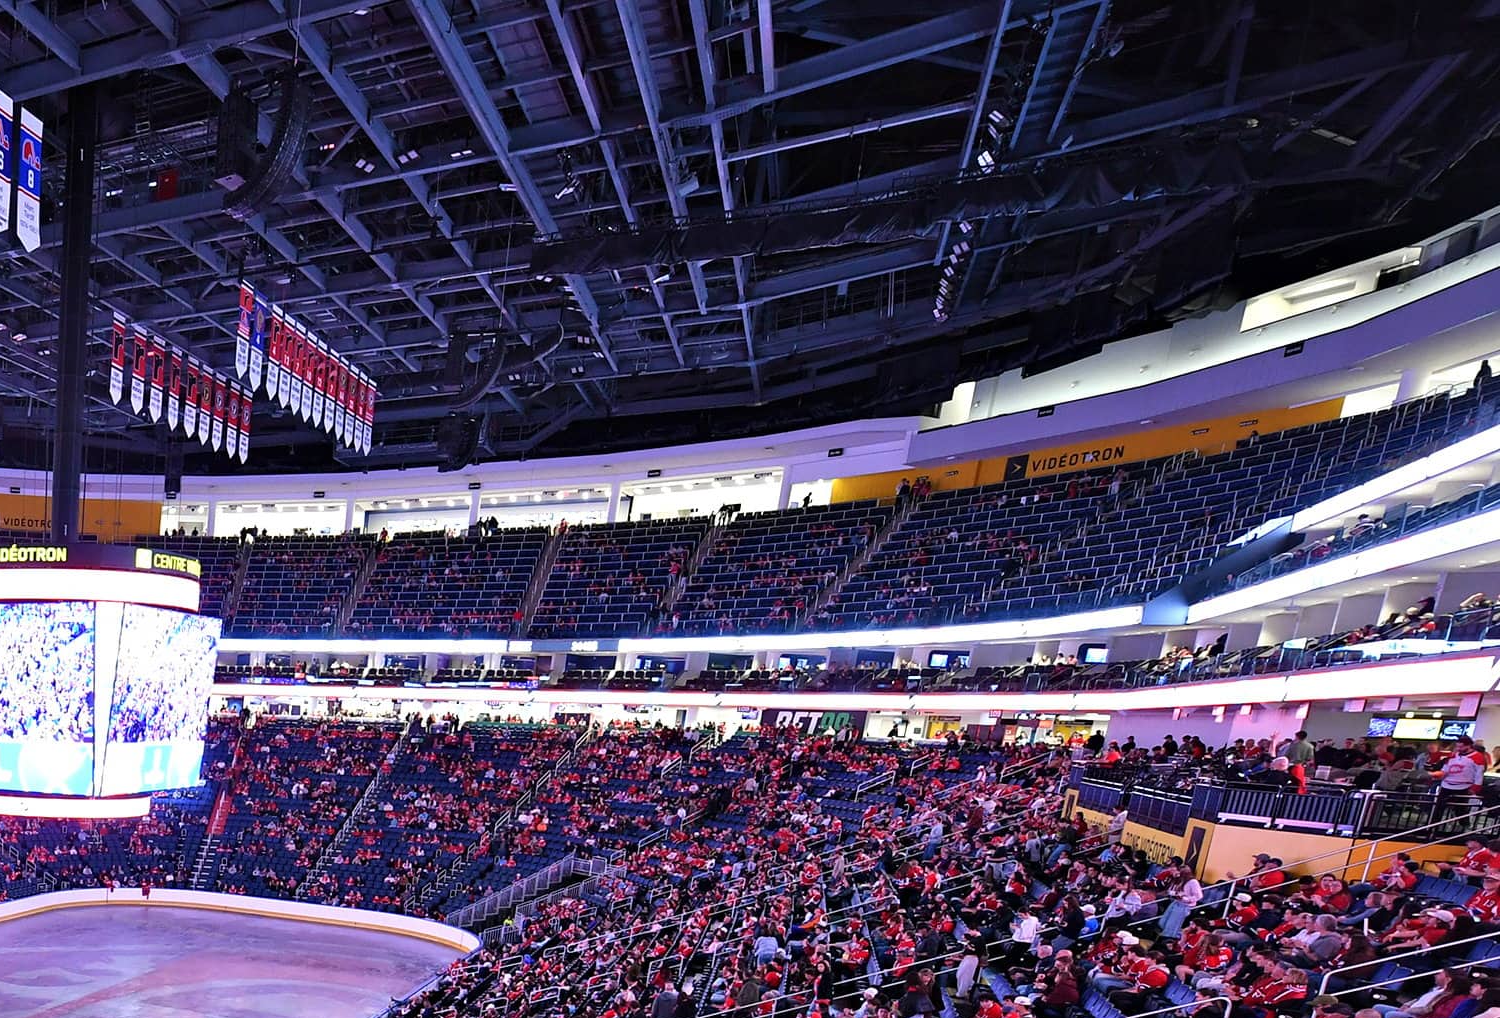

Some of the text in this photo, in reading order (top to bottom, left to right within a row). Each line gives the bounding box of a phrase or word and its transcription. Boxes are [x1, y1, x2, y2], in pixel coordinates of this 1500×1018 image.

[27, 169, 35, 189] 8
[1031, 445, 1126, 473] VIDÉOTRON
[3, 516, 52, 529] VIDÉOTRO
[153, 554, 187, 571] CENTRE
